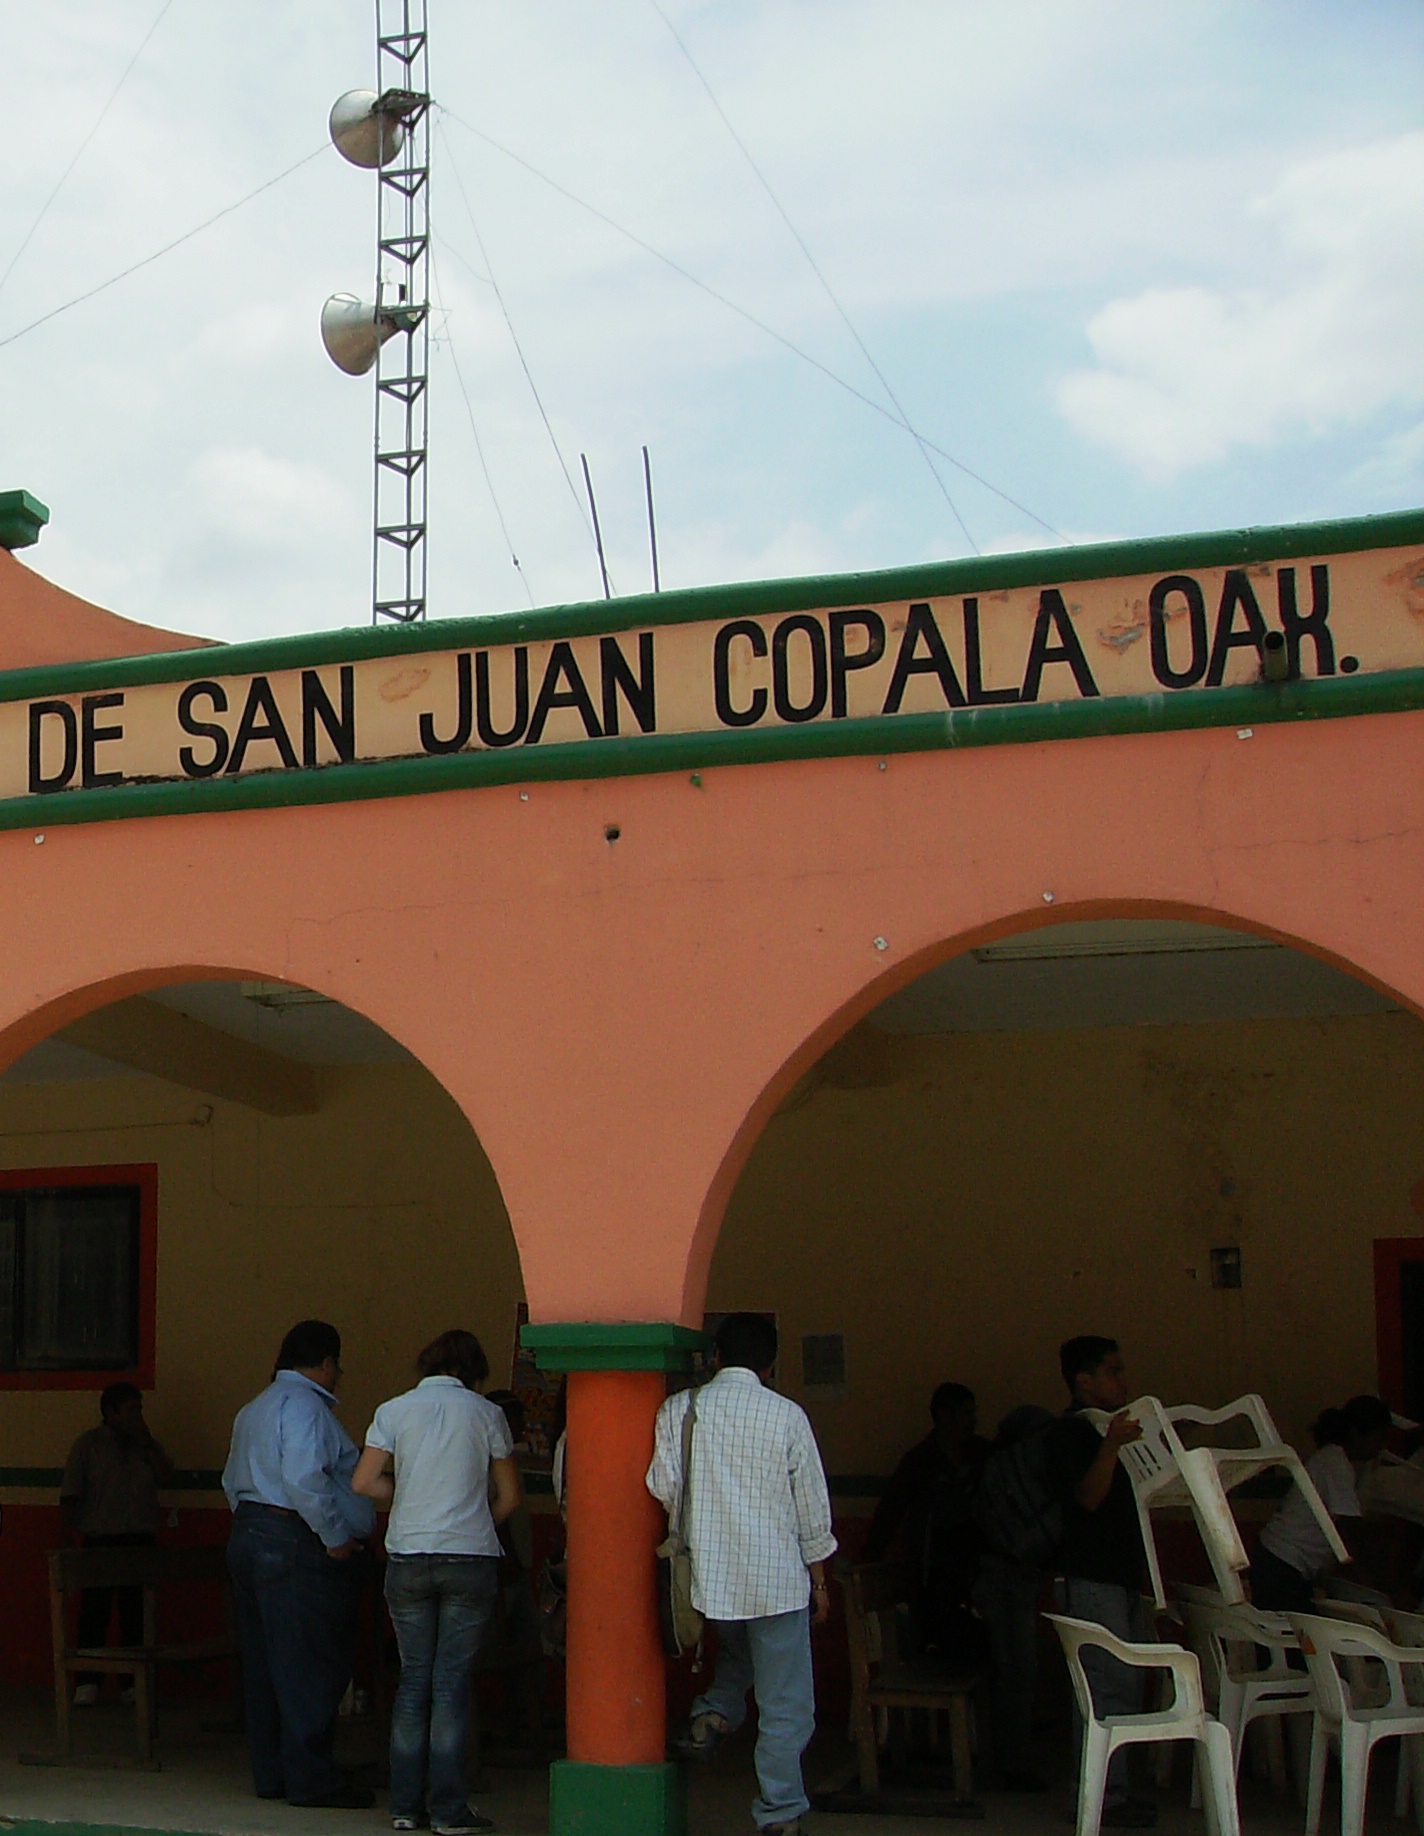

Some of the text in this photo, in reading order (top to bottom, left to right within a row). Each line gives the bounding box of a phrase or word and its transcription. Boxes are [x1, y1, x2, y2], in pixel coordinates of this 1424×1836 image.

[28, 693, 125, 792] DE
[177, 666, 356, 778] SAN
[419, 632, 656, 754] JUAN
[713, 588, 1101, 728] COPALA
